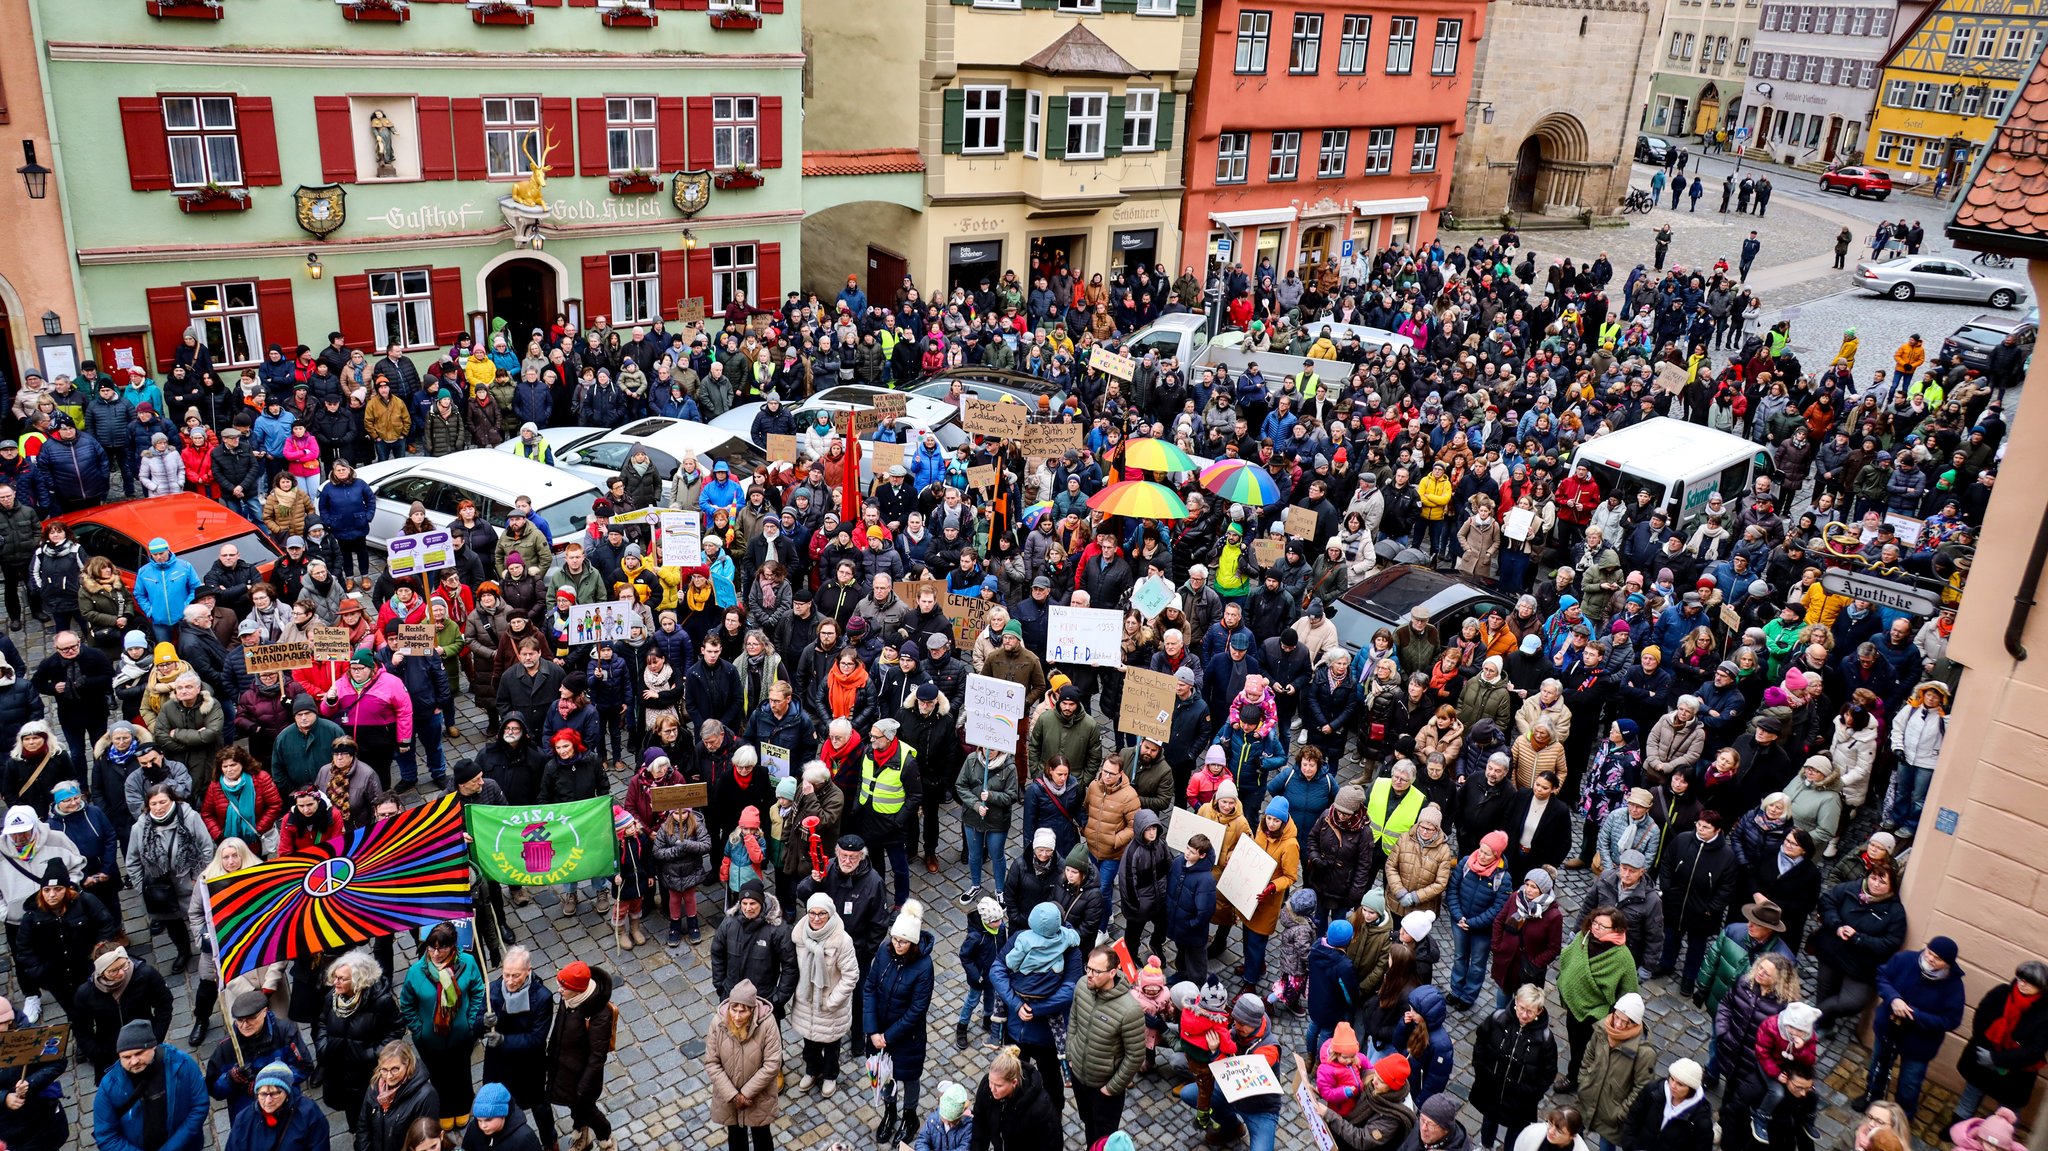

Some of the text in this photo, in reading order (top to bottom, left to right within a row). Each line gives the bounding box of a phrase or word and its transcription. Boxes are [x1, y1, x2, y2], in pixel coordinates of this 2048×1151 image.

[603, 197, 661, 219] Hirsch
[1112, 208, 1160, 221] Schönherr
[385, 203, 472, 231] Gasthof
[960, 218, 998, 232] Foto
[1344, 242, 1352, 255] P
[614, 516, 629, 524] NIE
[1841, 580, 1913, 610] Apotheke
[968, 609, 984, 620] FÜR
[1052, 608, 1068, 616] Was
[325, 627, 345, 636] Rechten
[405, 625, 426, 633] Rechte
[250, 641, 302, 655] WIR SIND DIE
[251, 651, 311, 665] BRANDMAUER
[970, 679, 1000, 698] Lieber
[974, 707, 992, 720] als
[1132, 719, 1167, 737] Menschen
[985, 733, 1010, 745] arisch
[766, 749, 783, 759] PLATZ
[1235, 1074, 1272, 1092] BUNT
